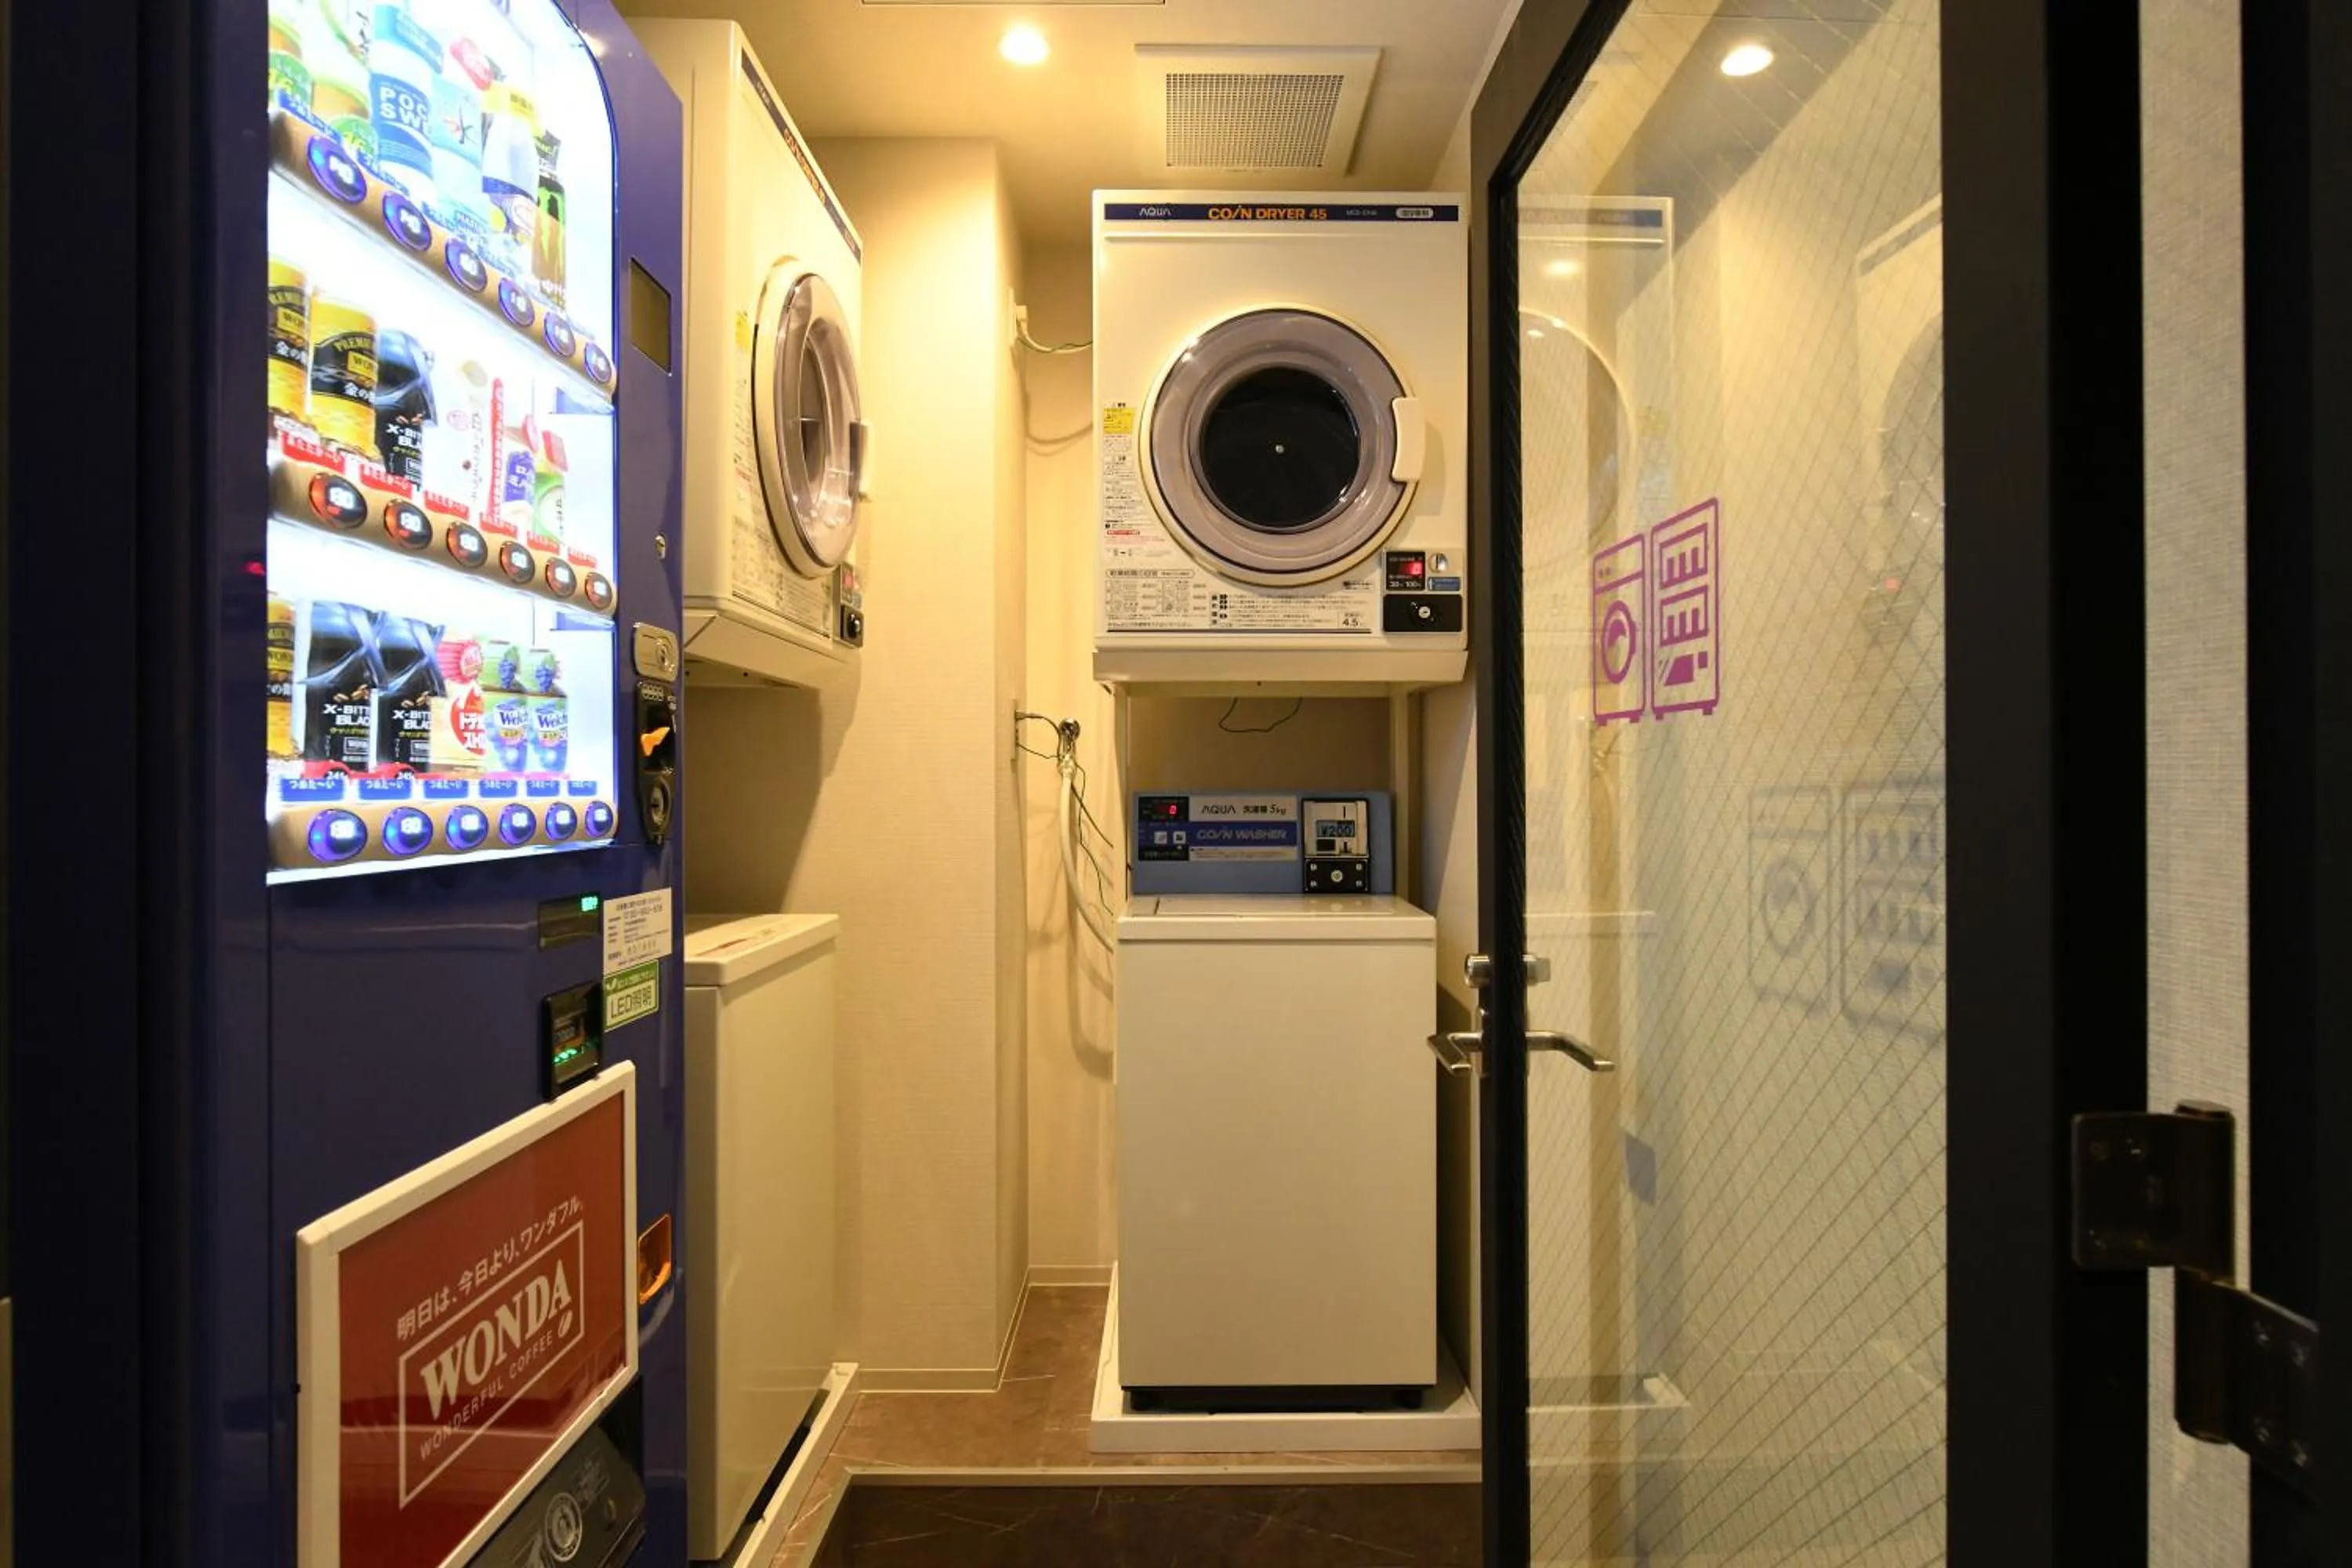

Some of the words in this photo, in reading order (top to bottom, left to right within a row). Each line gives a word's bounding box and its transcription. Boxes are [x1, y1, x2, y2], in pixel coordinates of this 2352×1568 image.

[1139, 206, 1171, 216] AQUA
[1256, 207, 1305, 220] DRYER
[1308, 208, 1328, 220] 45
[1202, 804, 1236, 815] AQUA
[420, 1258, 572, 1421] WONDA
[419, 1381, 504, 1461] WONDERFUL
[509, 1329, 554, 1381] COFFEE
